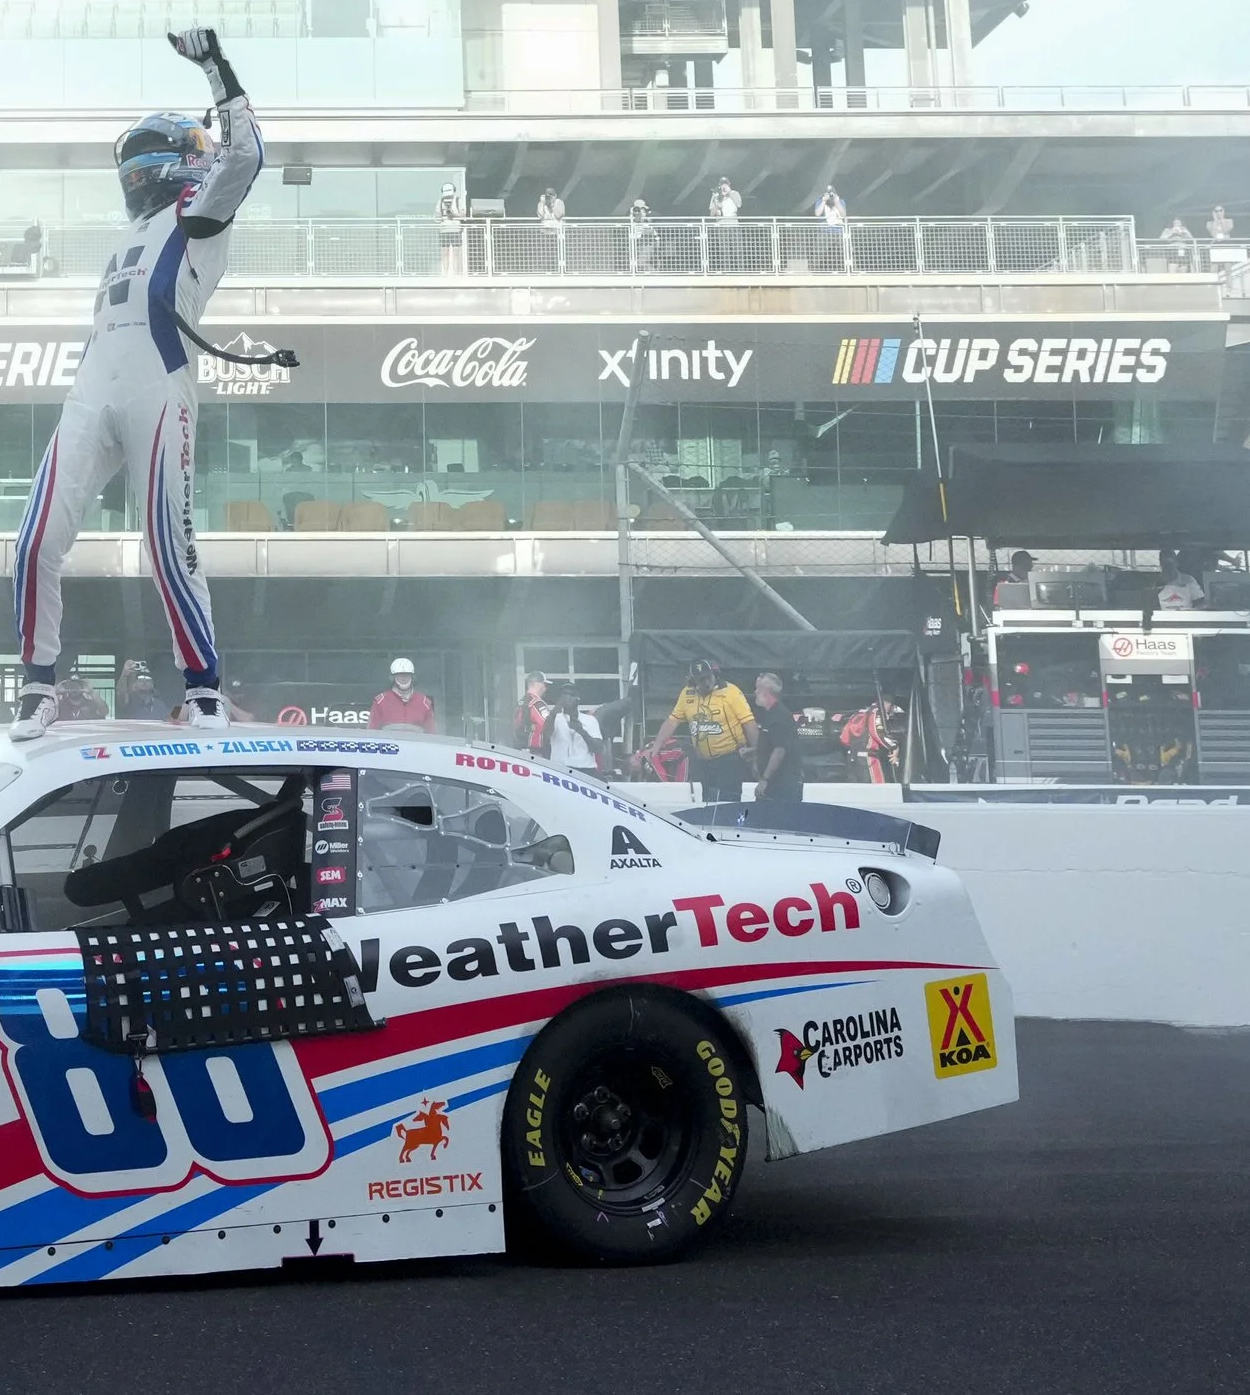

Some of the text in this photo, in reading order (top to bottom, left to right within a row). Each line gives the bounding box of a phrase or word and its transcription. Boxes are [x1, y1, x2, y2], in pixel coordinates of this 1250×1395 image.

[381, 337, 536, 388] Coca-Cola
[902, 338, 1171, 384] CUP SERIES
[217, 383, 270, 395] LIGHT
[1136, 639, 1177, 650] Haas
[311, 707, 370, 724] Haas
[120, 743, 200, 757] CONNOR
[218, 741, 292, 753] ZILISCH
[456, 753, 646, 822] ROTO-ROOTER
[320, 870, 341, 881] SEM
[610, 858, 662, 870] AXALTA
[803, 1007, 902, 1051] CAROLINA
[817, 1035, 904, 1078] CARPORTS
[940, 1044, 991, 1068] KOA
[526, 1068, 551, 1167] EAGLE
[368, 1172, 483, 1200] REGISTIX
